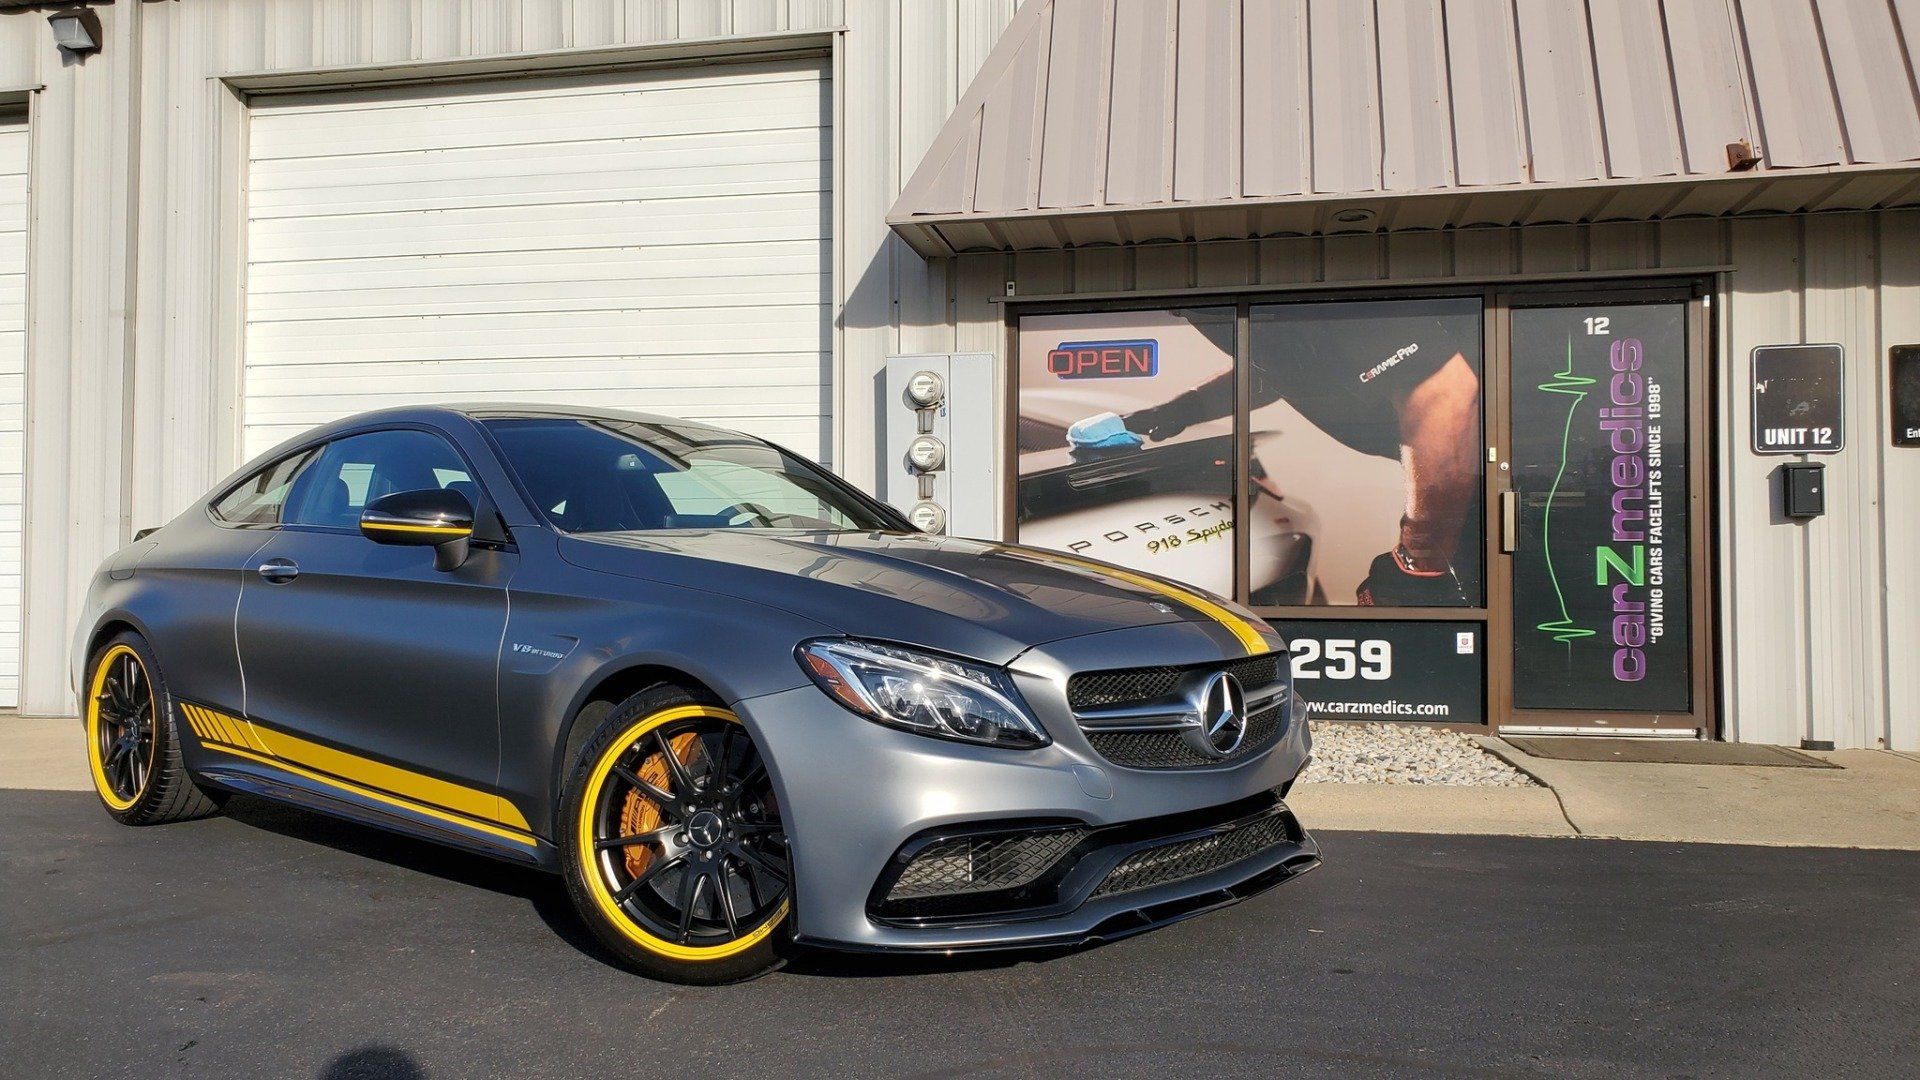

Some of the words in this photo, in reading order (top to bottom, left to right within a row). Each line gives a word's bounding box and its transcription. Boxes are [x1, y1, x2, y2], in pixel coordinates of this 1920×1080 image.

[1583, 316, 1610, 335] 12
[1048, 348, 1149, 375] OPEN
[1648, 425, 1661, 467] SINCE
[1764, 428, 1808, 446] UNIT
[1812, 427, 1832, 445] 12
[1067, 498, 1232, 553] PORSCH
[1597, 338, 1646, 682] carZmedics
[1649, 470, 1663, 545] FACELIFTS
[1147, 534, 1182, 554] 918
[1187, 519, 1236, 542] Spyde
[1650, 547, 1663, 586] CARS
[513, 643, 532, 653] V8
[1290, 638, 1392, 680] 259
